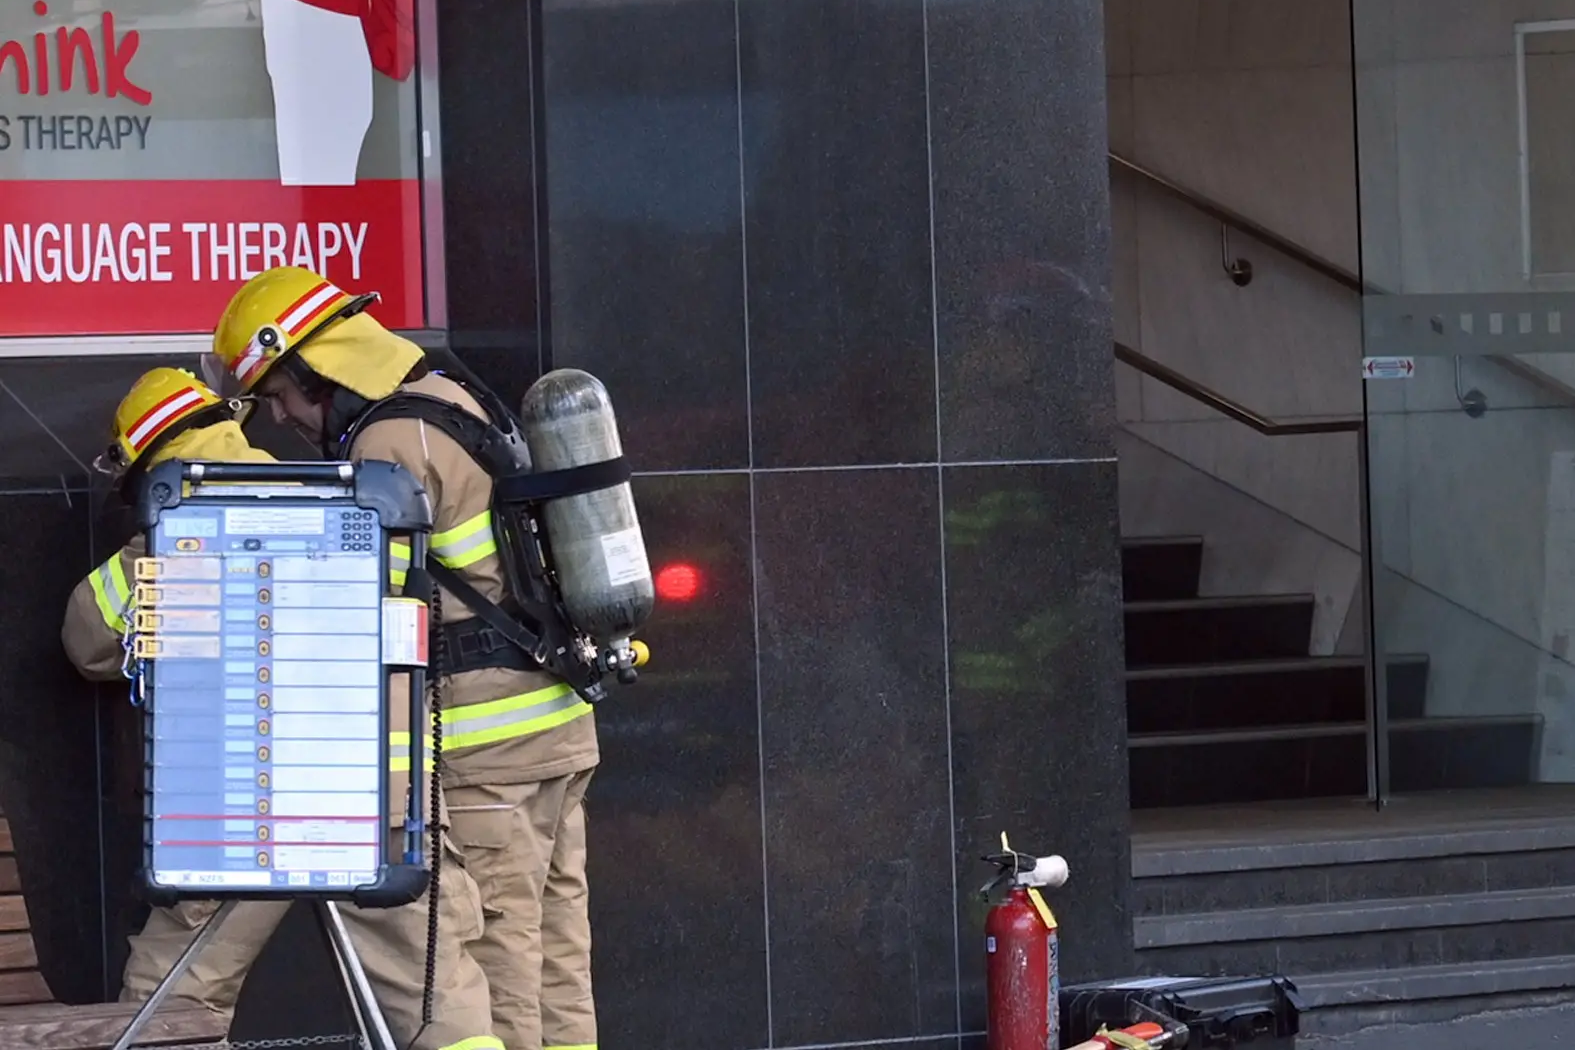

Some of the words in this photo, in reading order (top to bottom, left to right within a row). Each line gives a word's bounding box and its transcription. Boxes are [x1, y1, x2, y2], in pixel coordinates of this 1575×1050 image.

[17, 115, 152, 150] THERAPY
[0, 222, 173, 283] NGUAGE
[182, 222, 368, 282] THERAPY
